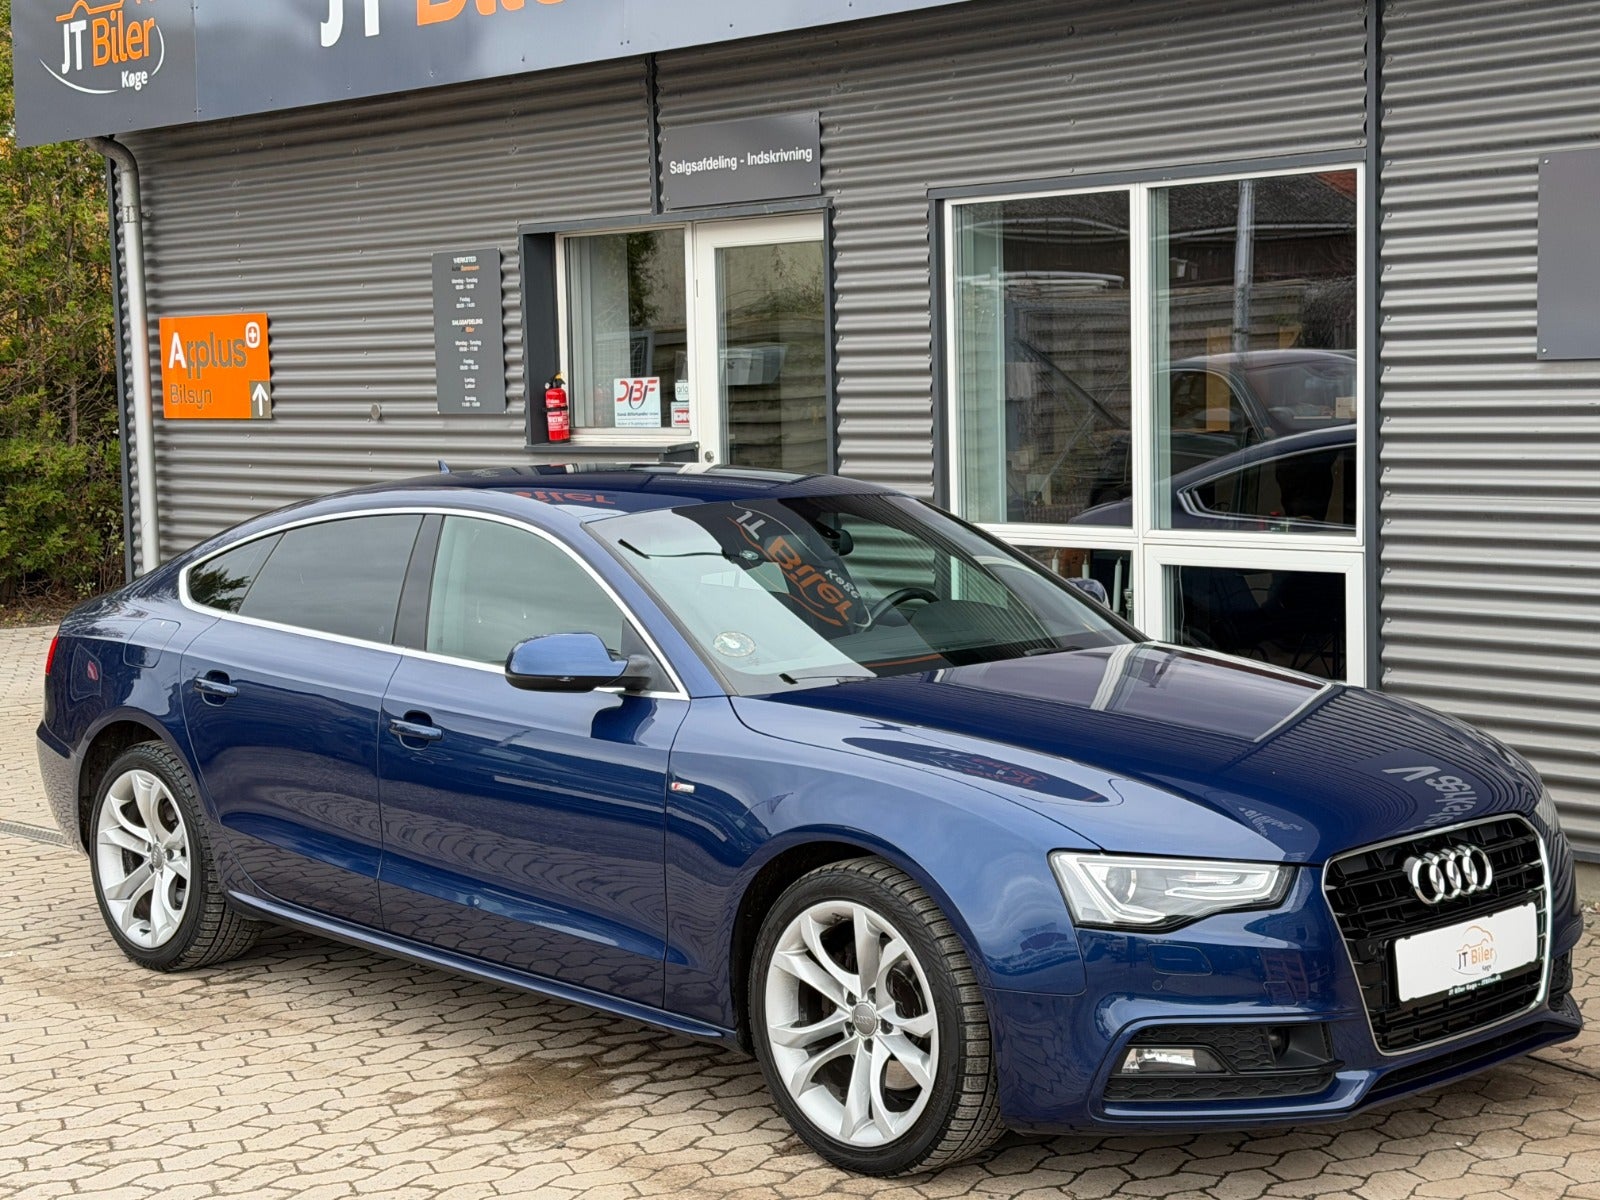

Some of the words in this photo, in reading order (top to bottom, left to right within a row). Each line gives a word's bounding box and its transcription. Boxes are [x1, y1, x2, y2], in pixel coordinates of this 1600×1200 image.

[62, 20, 87, 74] JT
[92, 10, 155, 67] Biler
[121, 70, 148, 91] Køge
[669, 155, 738, 176] Salgsafdeling
[747, 146, 813, 166] Indskrivning
[170, 383, 212, 410] Bilsyn
[1458, 951, 1468, 970] JT
[1471, 946, 1494, 965] Biler
